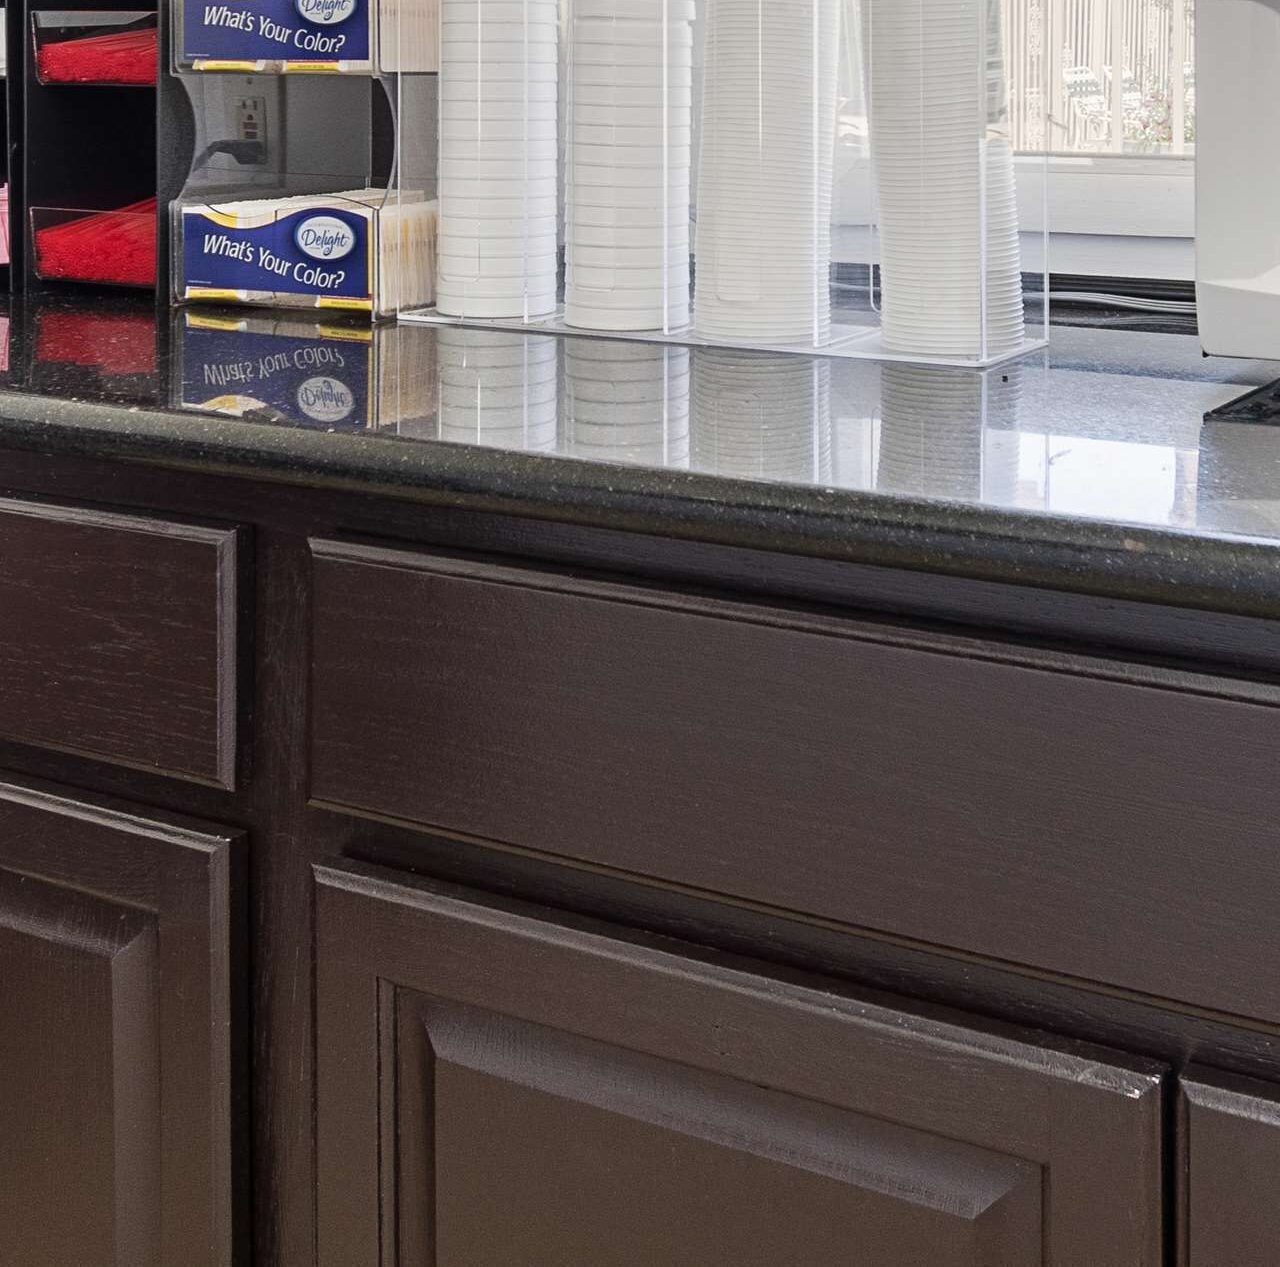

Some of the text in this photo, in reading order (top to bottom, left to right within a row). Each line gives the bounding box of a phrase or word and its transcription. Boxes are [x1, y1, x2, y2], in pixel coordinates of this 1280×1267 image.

[204, 6, 345, 53] What's Your Color?
[203, 234, 345, 289] What's Your Color?
[301, 229, 350, 256] Delight
